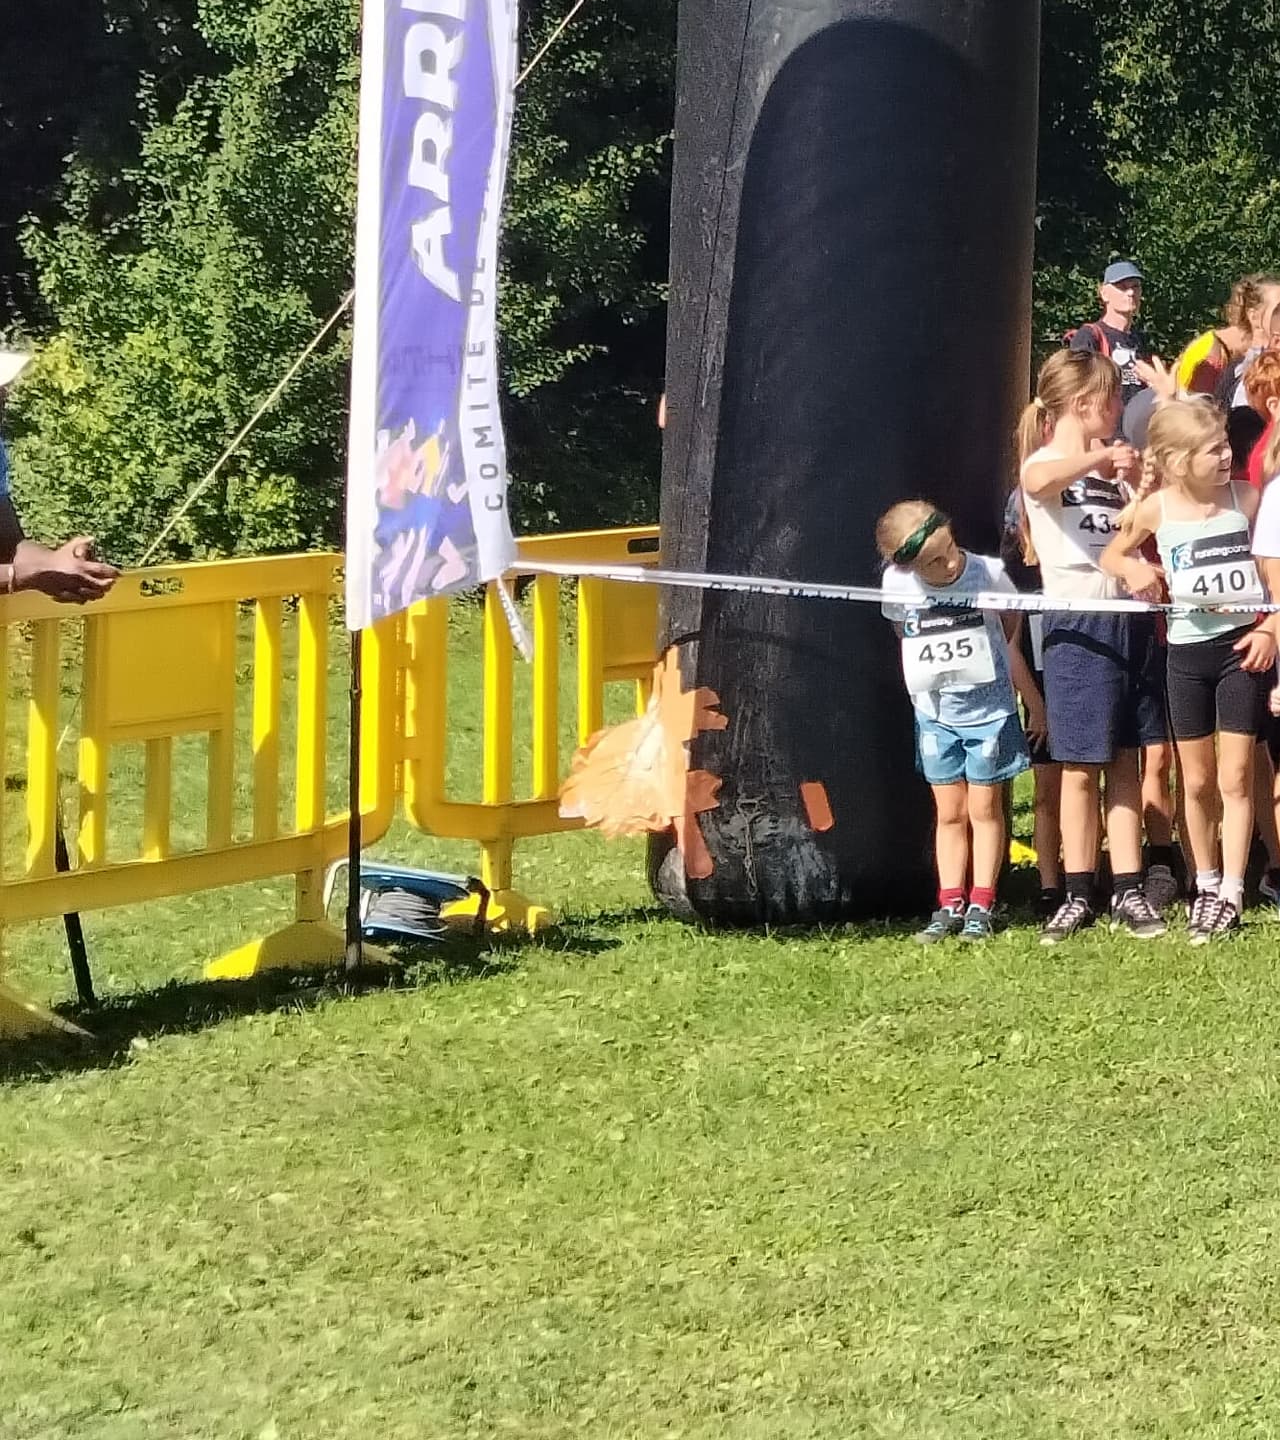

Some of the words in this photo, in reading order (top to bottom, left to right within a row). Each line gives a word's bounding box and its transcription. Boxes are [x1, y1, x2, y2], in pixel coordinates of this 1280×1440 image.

[1079, 513, 1122, 534] 43
[1192, 569, 1246, 596] 410
[918, 637, 973, 665] 435
